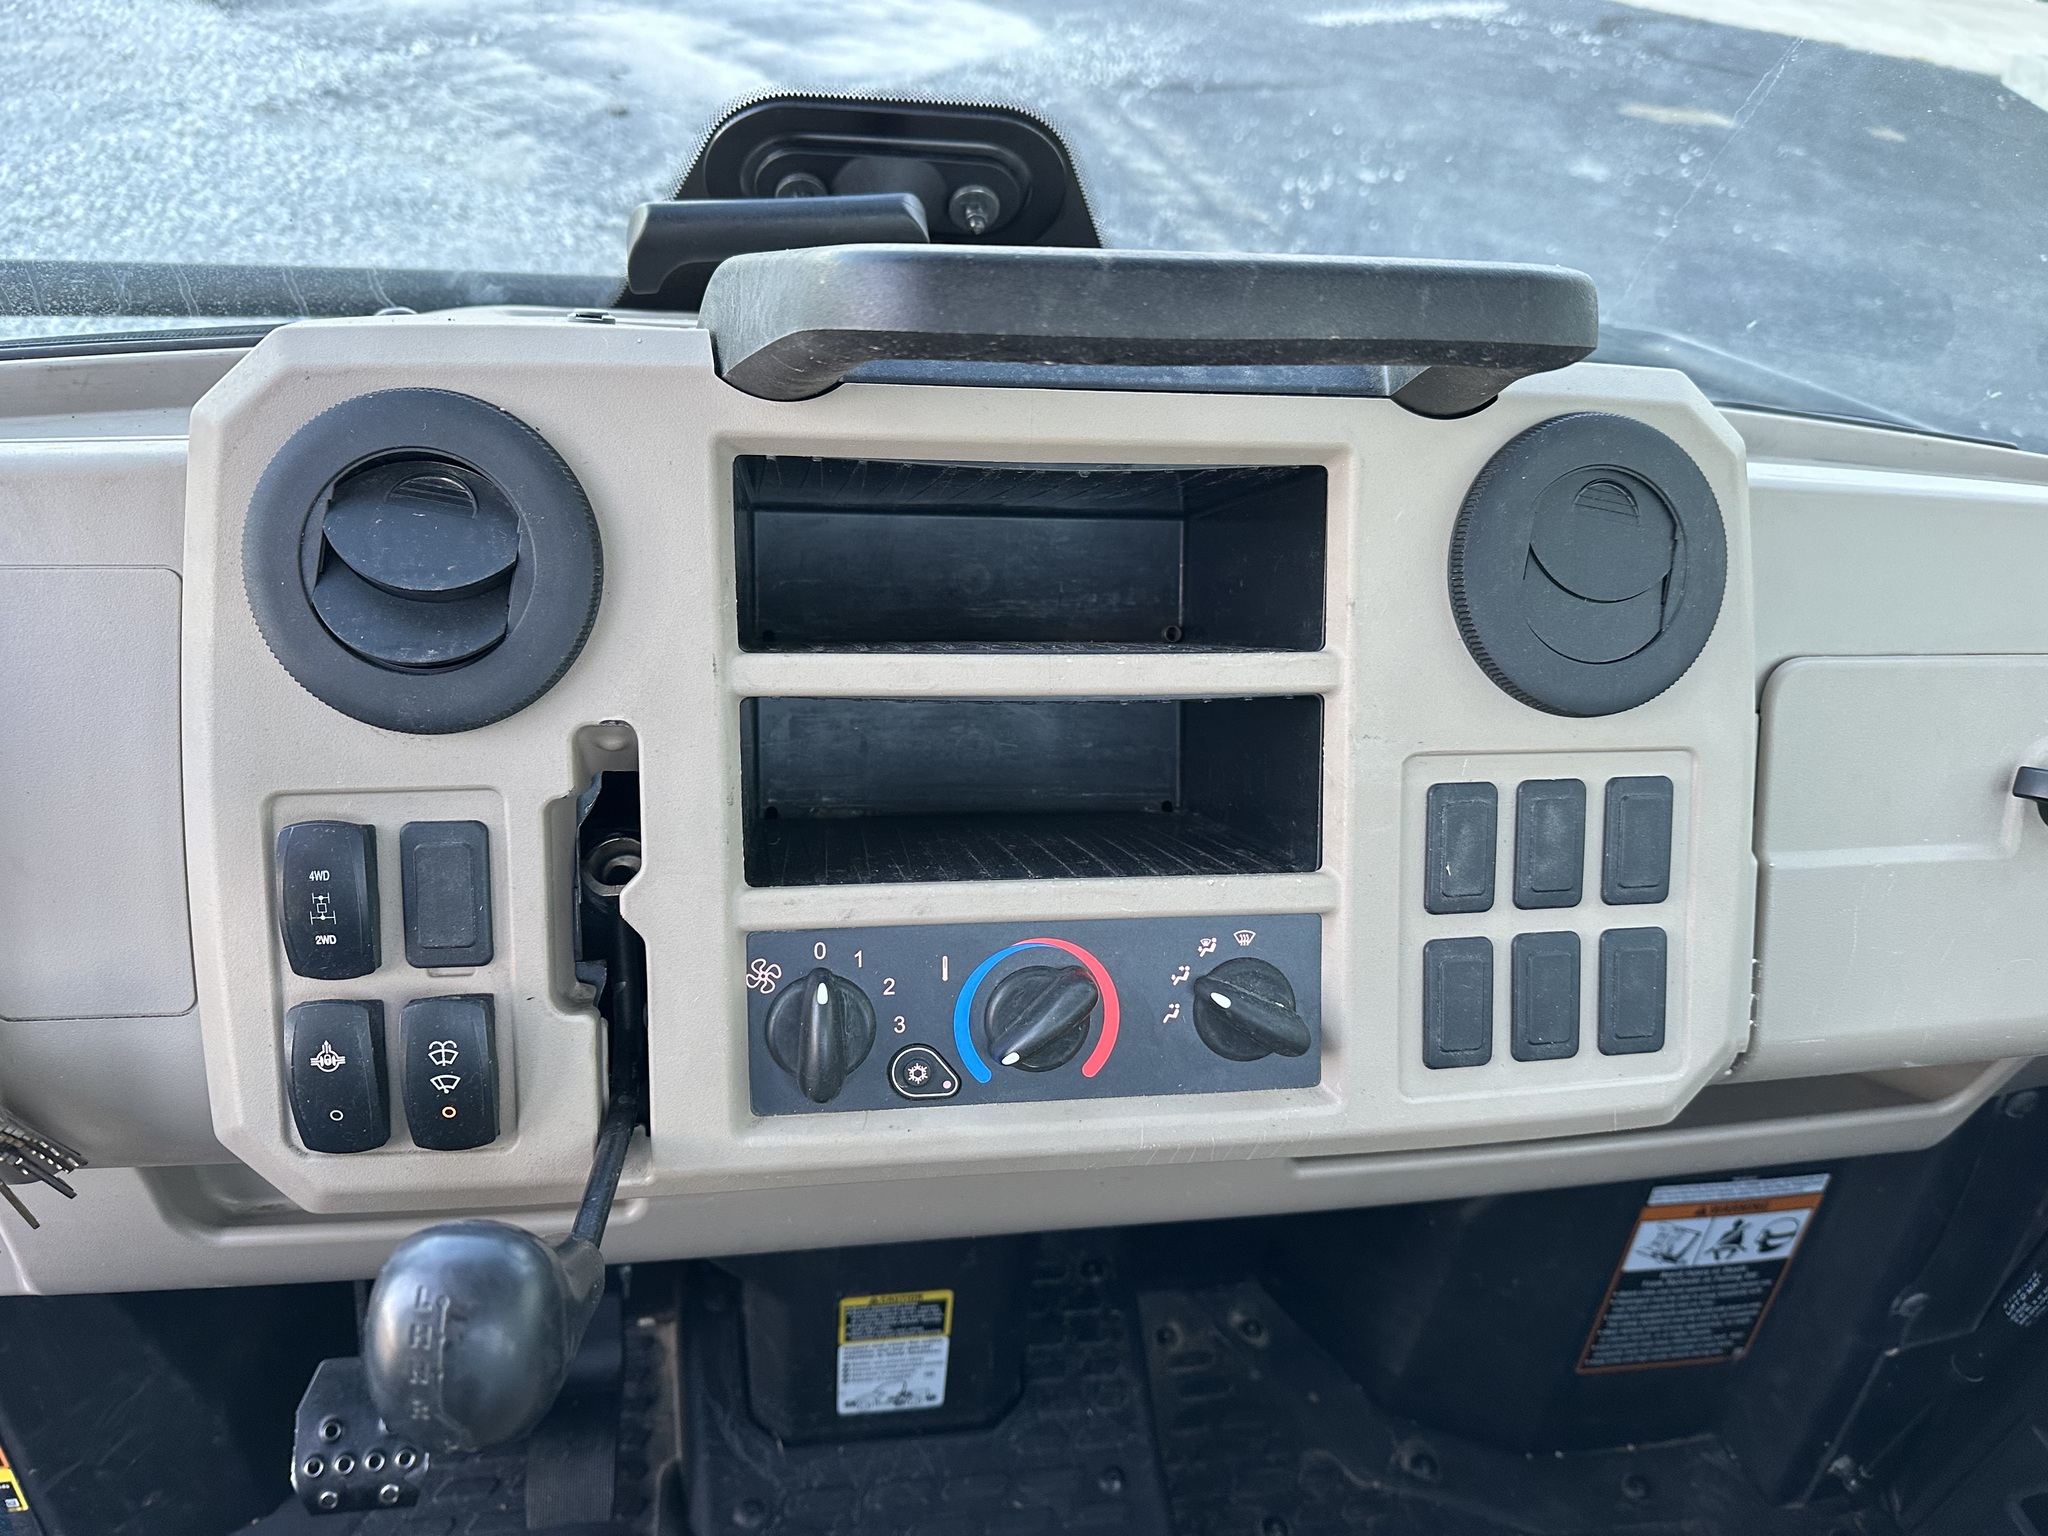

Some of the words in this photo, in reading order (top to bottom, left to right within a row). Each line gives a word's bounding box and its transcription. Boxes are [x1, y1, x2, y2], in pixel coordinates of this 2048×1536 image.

[309, 870, 330, 881] 4WD
[315, 934, 337, 945] 2WD
[814, 942, 827, 960] 0
[854, 950, 863, 968] 1
[883, 977, 896, 995] 2
[894, 1015, 906, 1033] 3
[415, 1285, 432, 1311] L
